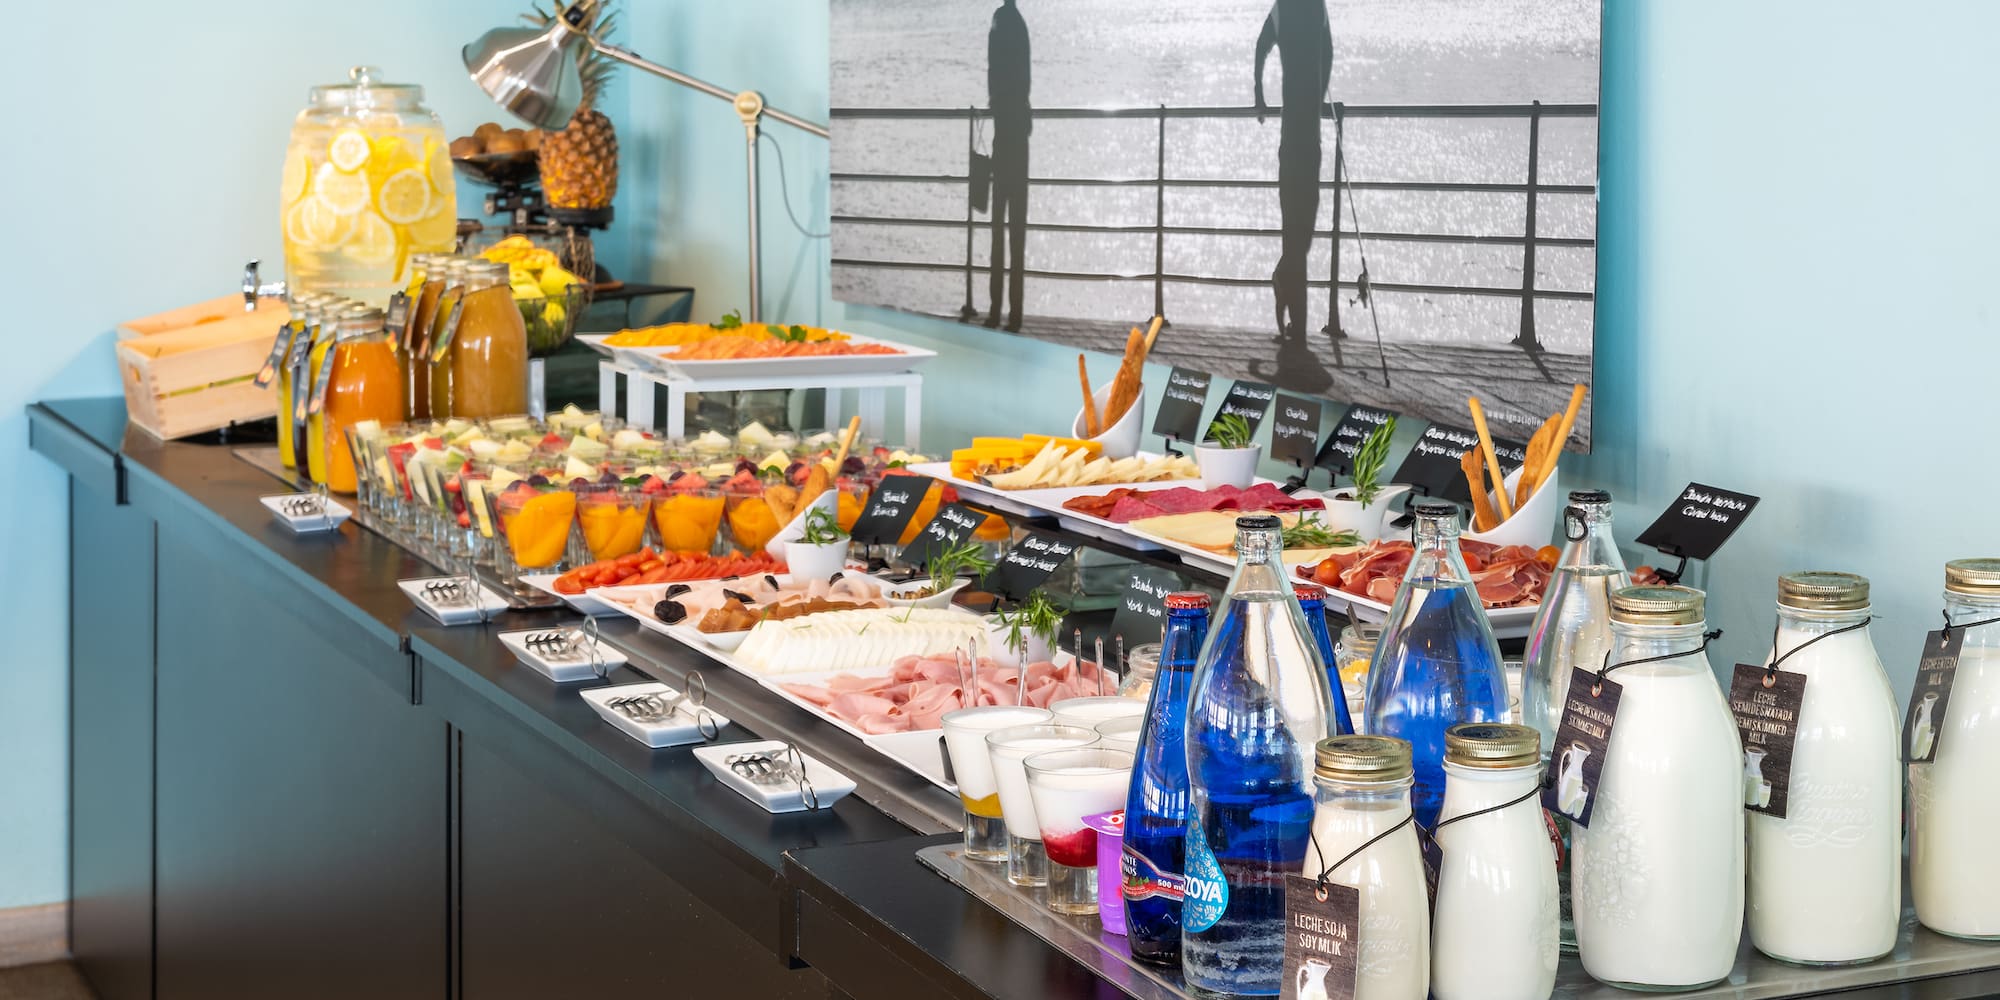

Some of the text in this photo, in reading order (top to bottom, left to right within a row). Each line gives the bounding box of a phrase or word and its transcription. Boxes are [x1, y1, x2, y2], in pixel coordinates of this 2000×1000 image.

[1126, 599, 1162, 617] York ham
[1753, 690, 1777, 706] LECHE
[1732, 700, 1793, 721] SEMIDESNATADA
[1748, 731, 1767, 745] MILK
[1157, 878, 1172, 889] 500
[1184, 873, 1223, 904] ZOYA
[1294, 913, 1323, 934] LECHE
[1324, 919, 1348, 941] SOJA
[1299, 933, 1317, 949] SOY
[1318, 939, 1342, 956] MLIK
